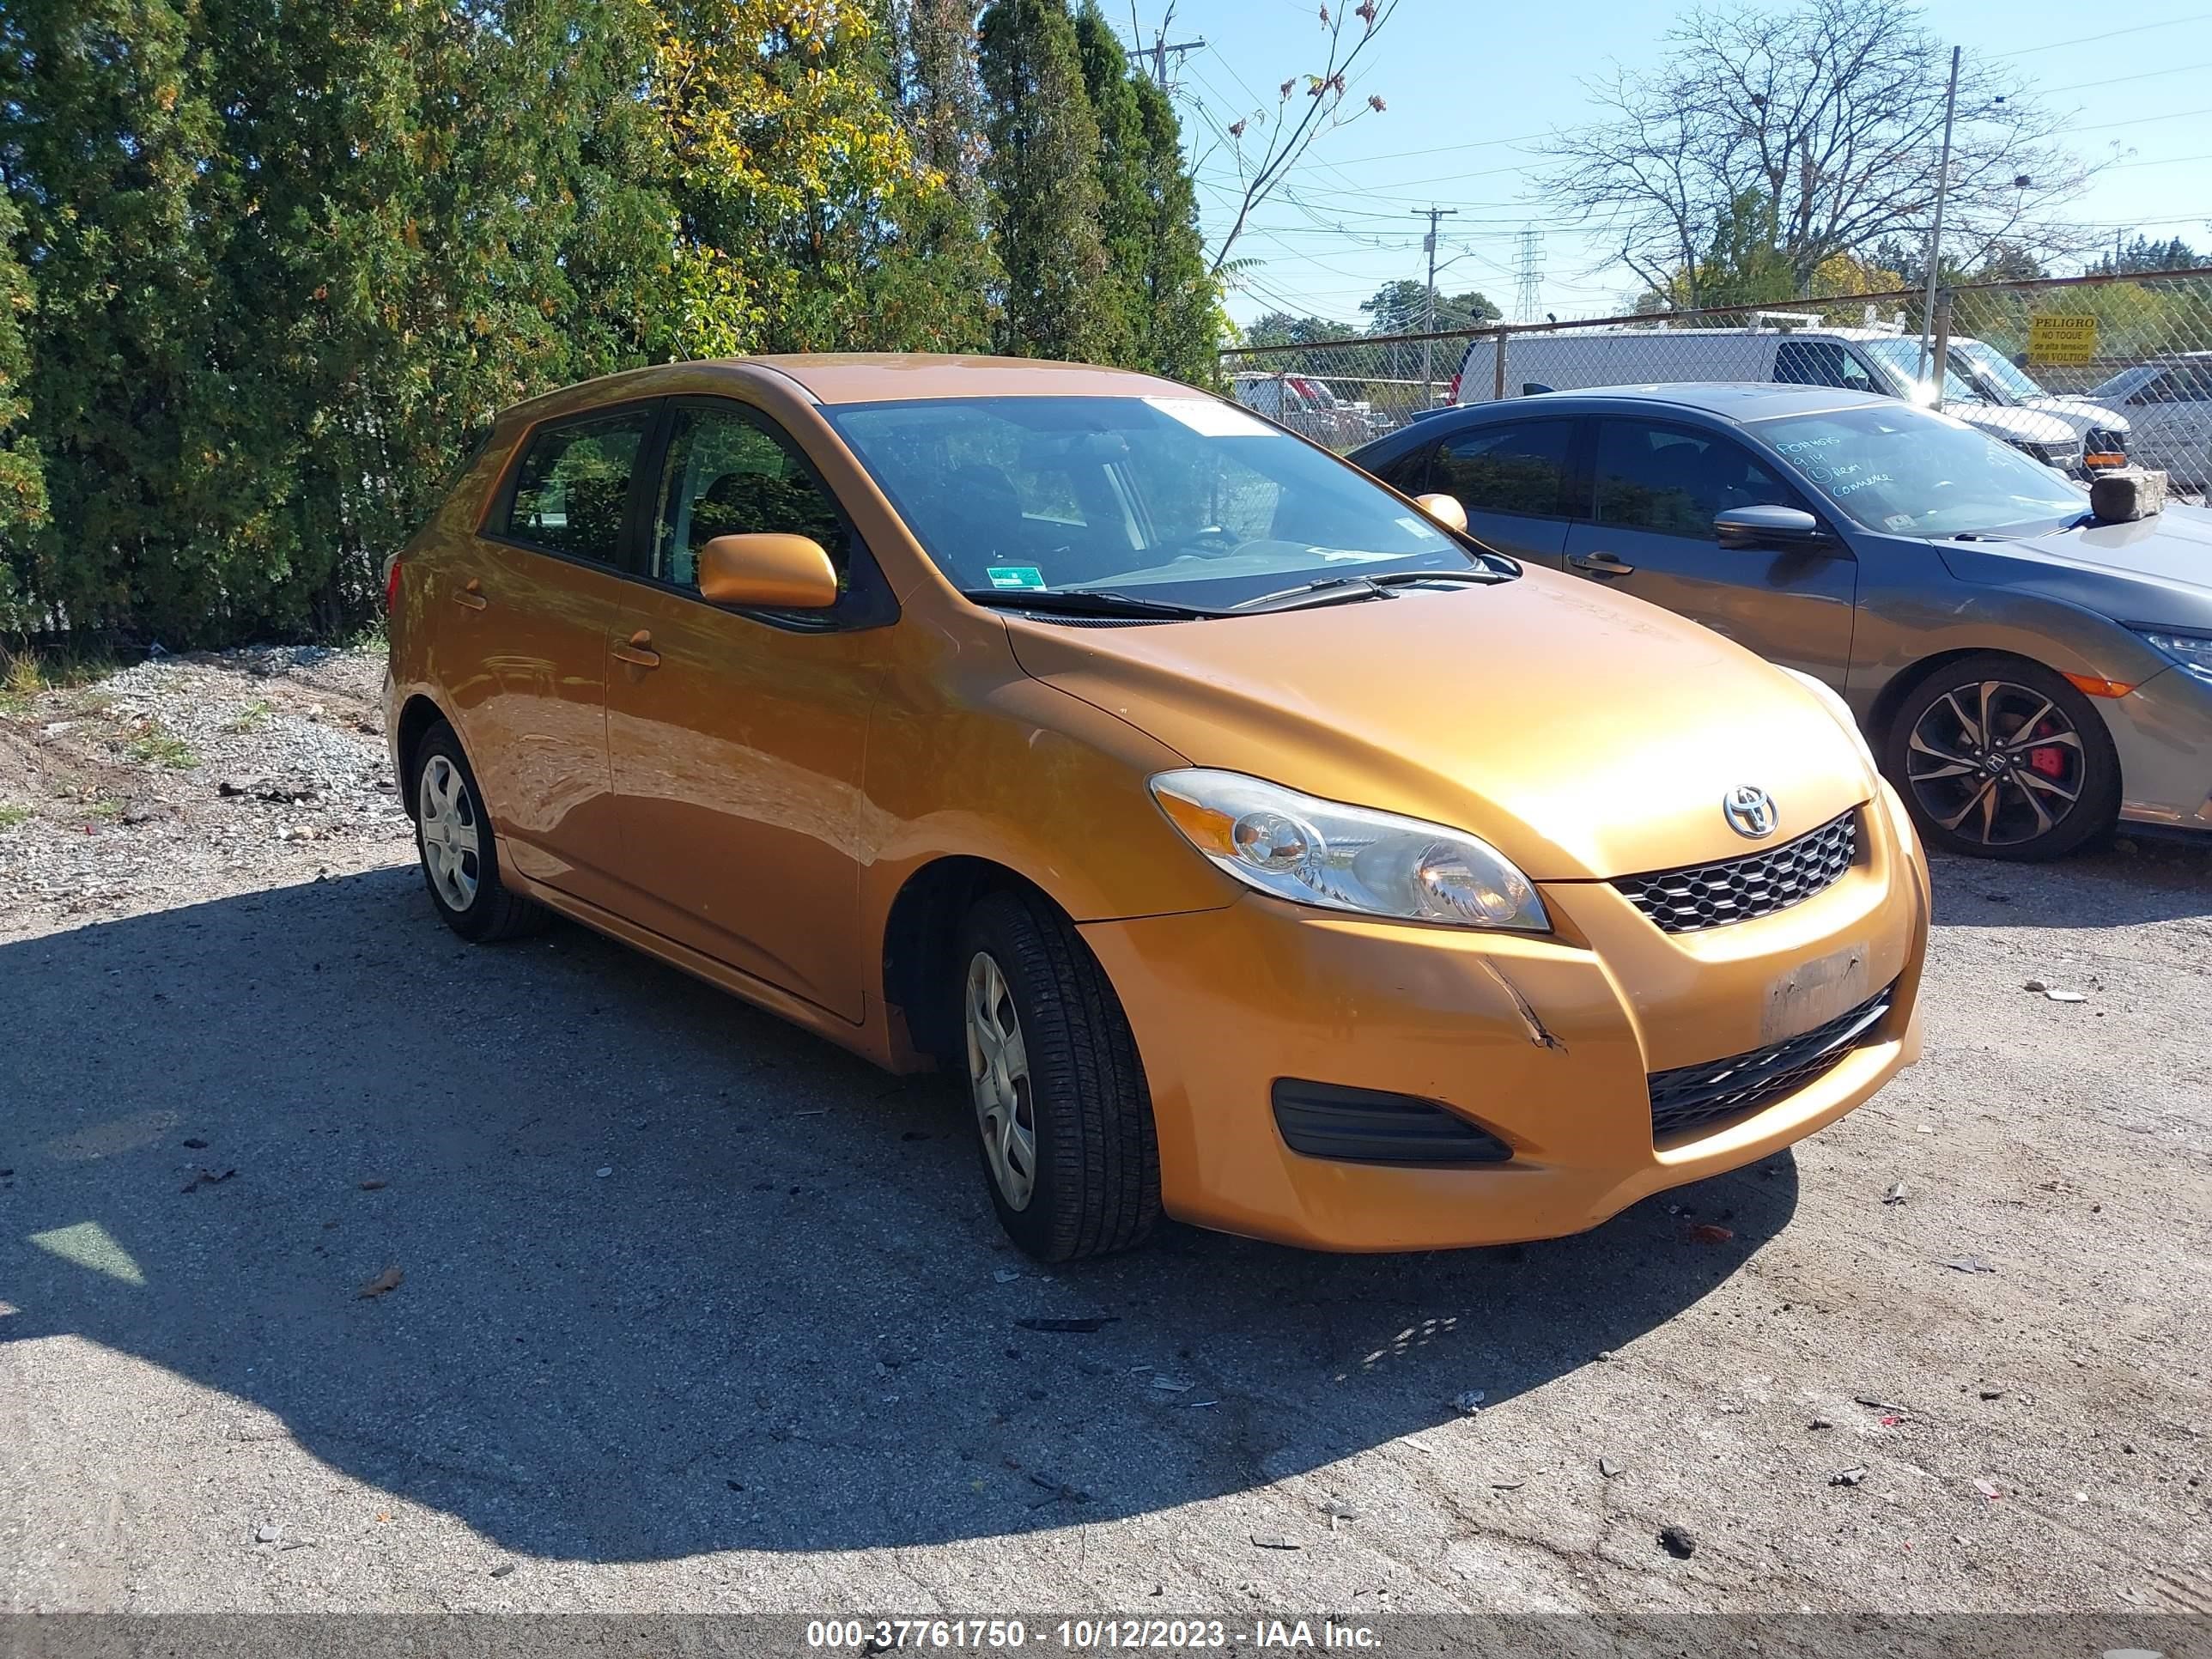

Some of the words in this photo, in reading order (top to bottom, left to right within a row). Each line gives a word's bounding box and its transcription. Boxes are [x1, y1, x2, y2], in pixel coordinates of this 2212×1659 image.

[2035, 318, 2094, 328] PELIGRO
[2041, 331, 2053, 340] NO
[2055, 331, 2082, 340] TOQUE
[2051, 353, 2089, 362] VOLTIOS
